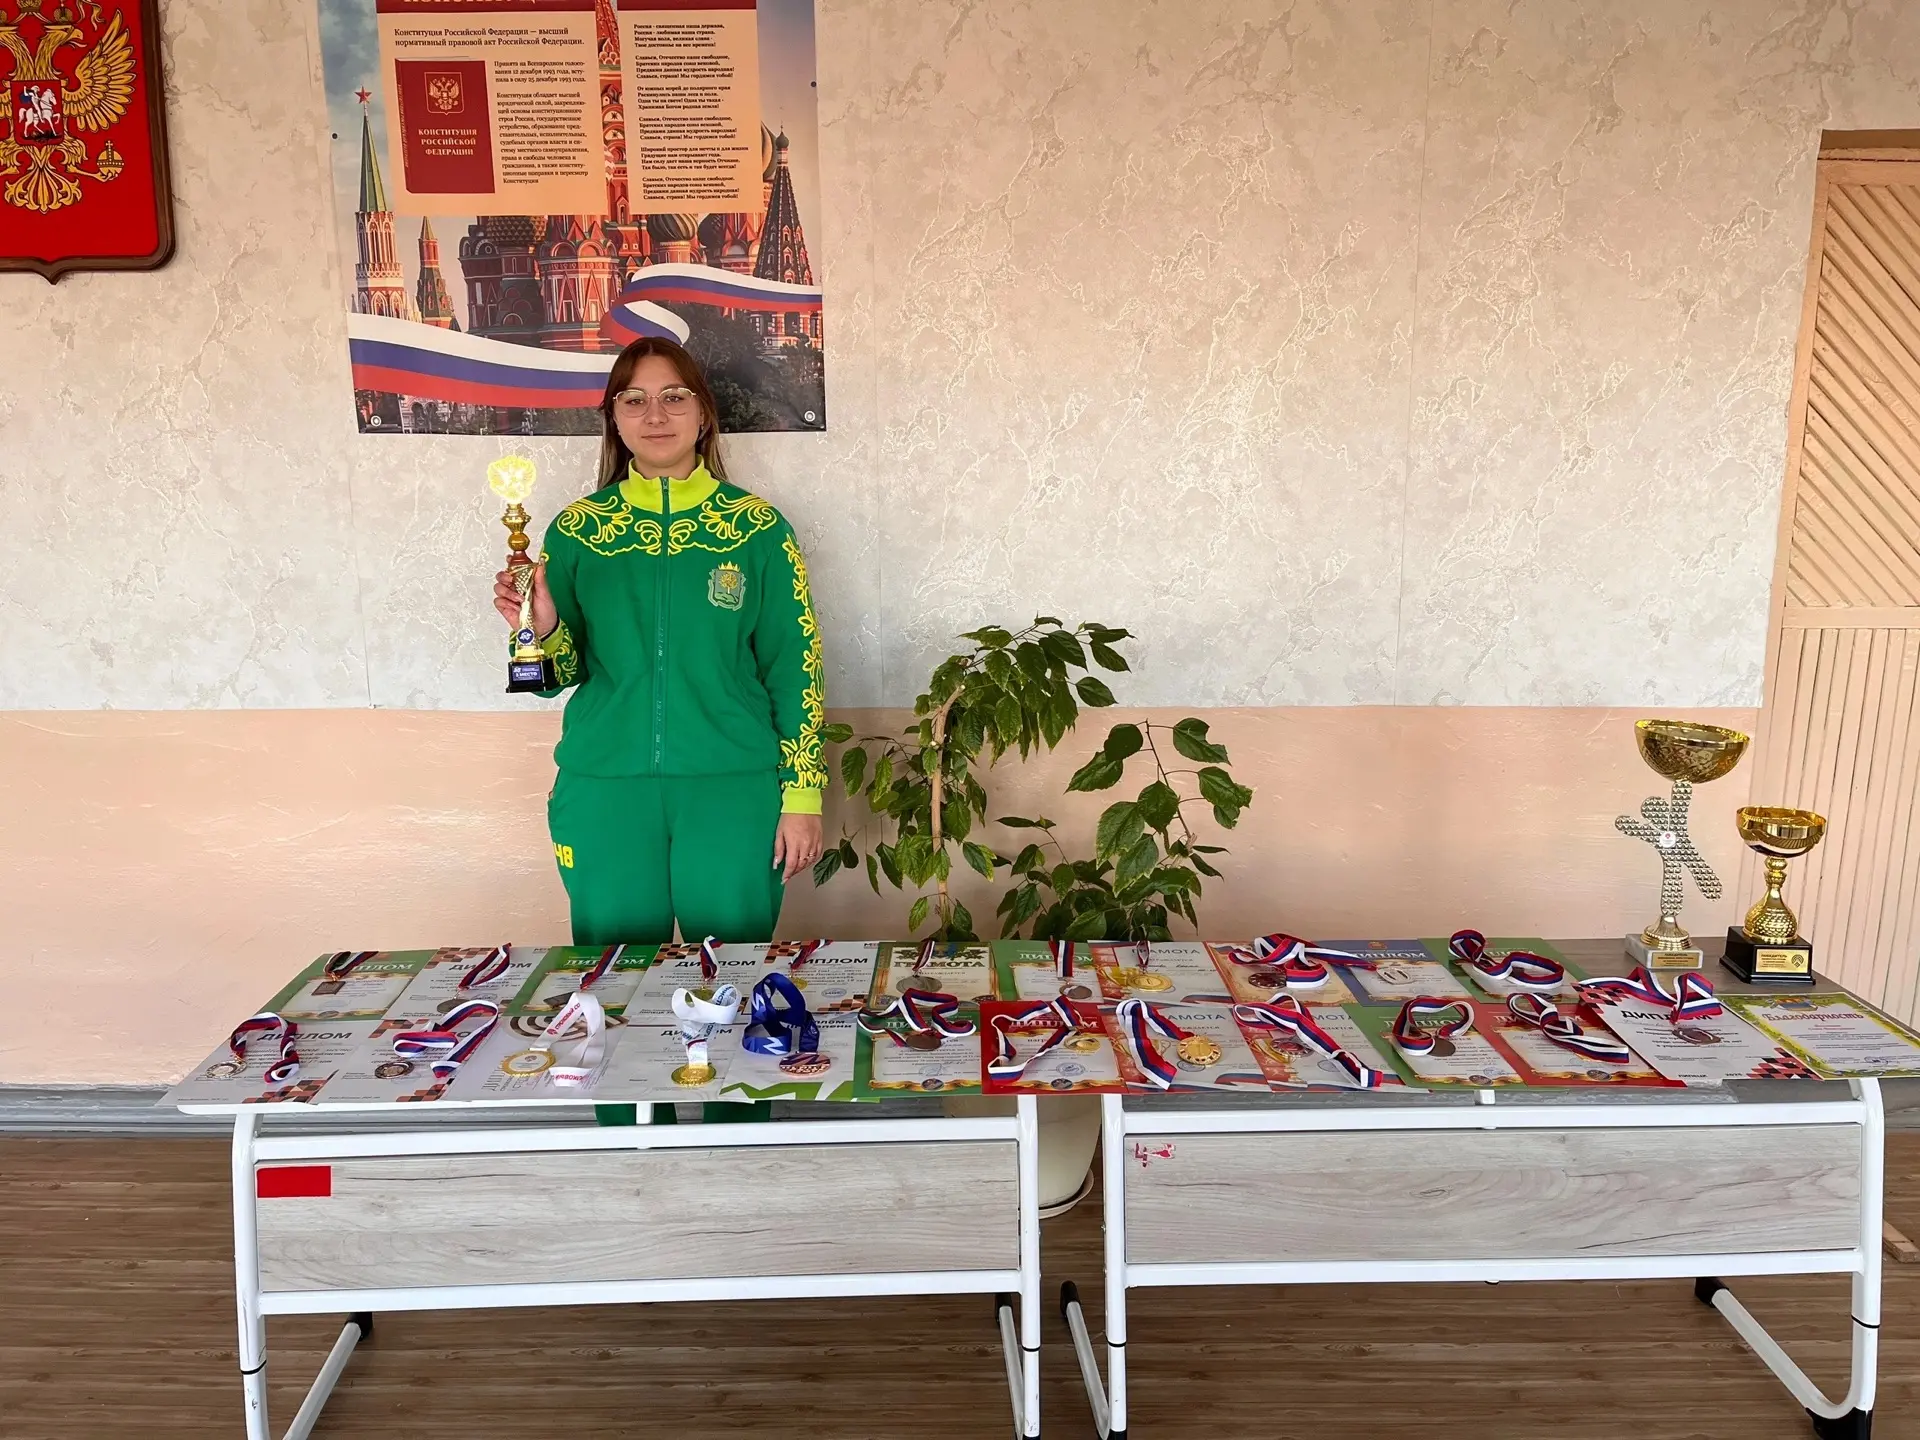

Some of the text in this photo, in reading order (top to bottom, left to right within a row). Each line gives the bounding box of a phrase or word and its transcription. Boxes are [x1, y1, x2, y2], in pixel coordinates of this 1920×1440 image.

[394, 29, 442, 38] Конституция
[488, 28, 528, 37] Федерации
[395, 38, 446, 47] нормативный
[448, 38, 482, 47] правовой
[542, 38, 585, 46] Федерации.
[1762, 1013, 1864, 1022] Благодарность
